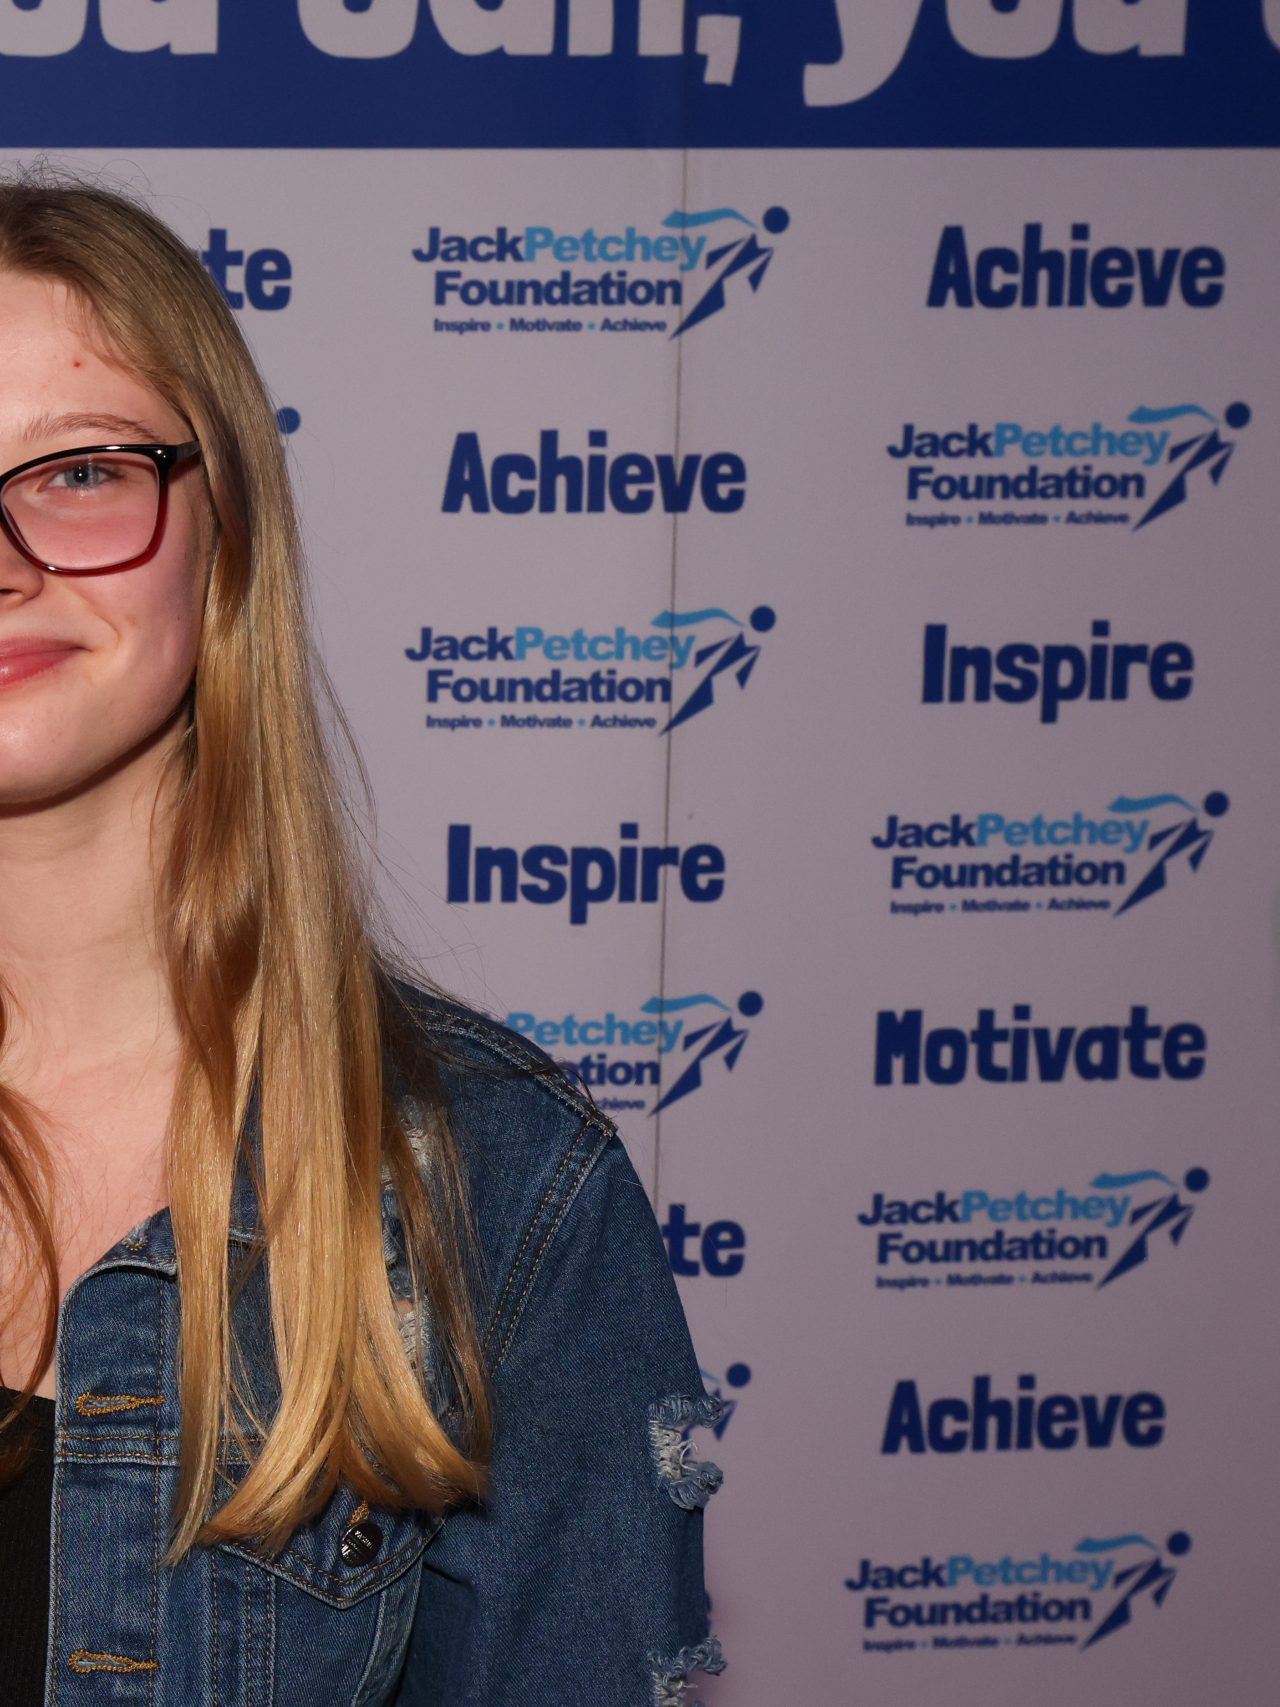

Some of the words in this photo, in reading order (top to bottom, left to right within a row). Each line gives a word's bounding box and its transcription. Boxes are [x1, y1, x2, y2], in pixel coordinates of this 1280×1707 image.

[927, 223, 1225, 308] Achieve
[435, 271, 683, 306] Foundation
[433, 318, 492, 335] Inspire
[509, 317, 584, 333] Motivate
[599, 317, 668, 332] Achieve
[442, 430, 746, 514] Achieve
[908, 466, 1145, 500] Foundation
[427, 669, 673, 703] Foundation
[922, 620, 1194, 724] Inspire
[425, 714, 484, 732] Inspire
[500, 714, 574, 729] Motivate
[590, 714, 657, 729] Achieve
[447, 823, 725, 925] Inspire
[892, 853, 1126, 889] Foundation
[875, 1005, 1207, 1085] Motivate
[878, 1228, 1108, 1264] Foundation
[881, 1374, 1166, 1454] Achieve
[865, 1593, 1092, 1628] Foundation
